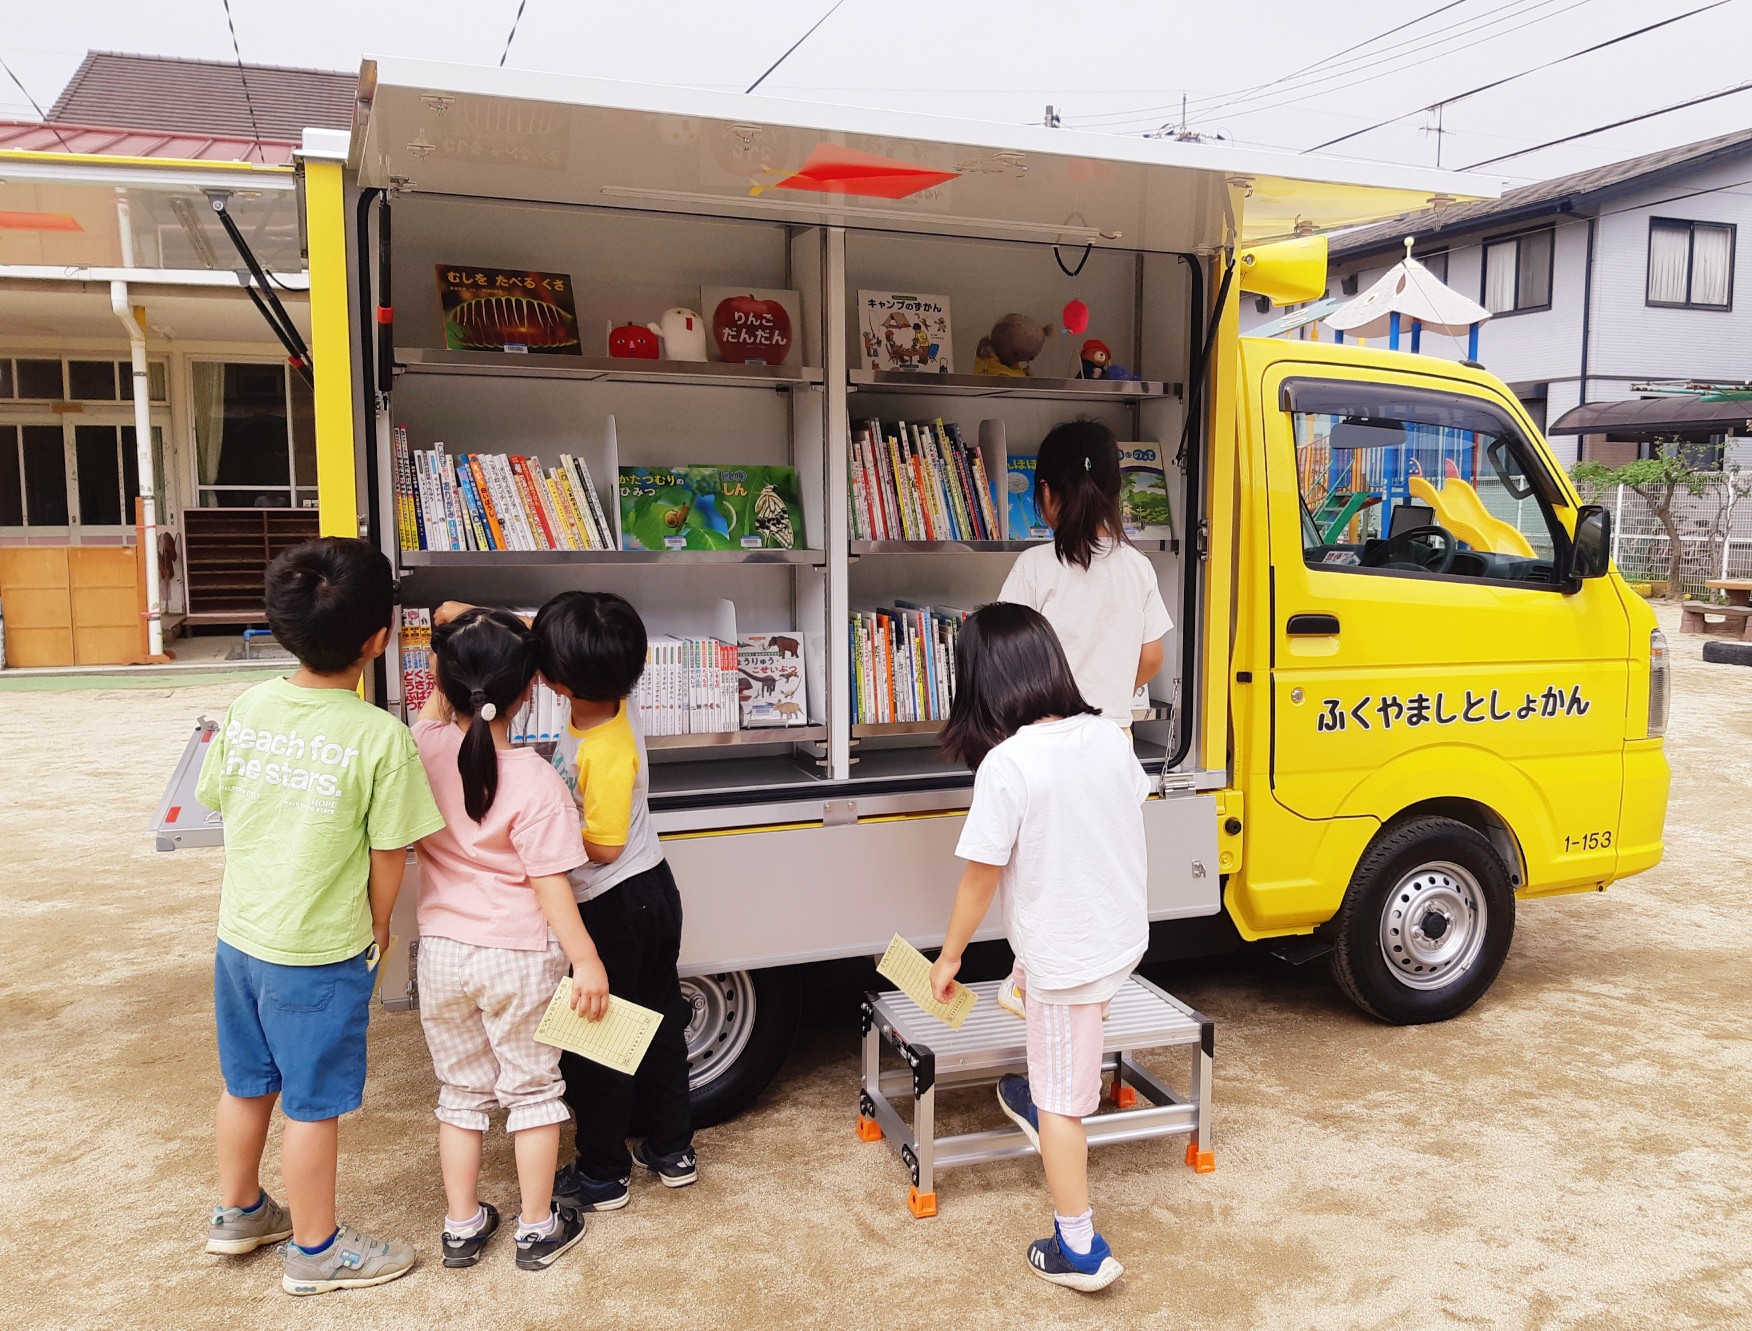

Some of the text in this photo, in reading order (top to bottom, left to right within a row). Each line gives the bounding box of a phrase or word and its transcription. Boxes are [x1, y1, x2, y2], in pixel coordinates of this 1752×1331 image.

[447, 271, 565, 291] むしを たべる くさ
[868, 299, 942, 313] キャンプのずかん
[734, 311, 774, 326] りんご
[722, 327, 787, 345] だんだん
[619, 474, 685, 486] かたつむりの
[620, 487, 656, 497] ひみつ
[480, 487, 495, 518] 白いぼうし
[752, 665, 797, 674] こせいぶつ
[403, 670, 418, 711] どうぶつ
[1317, 685, 1591, 732] ふくやましとしょかん
[311, 735, 359, 768] for
[220, 749, 262, 780] he
[265, 761, 342, 797] stars.
[312, 799, 337, 808] HOPE
[1563, 830, 1612, 853] 1-153
